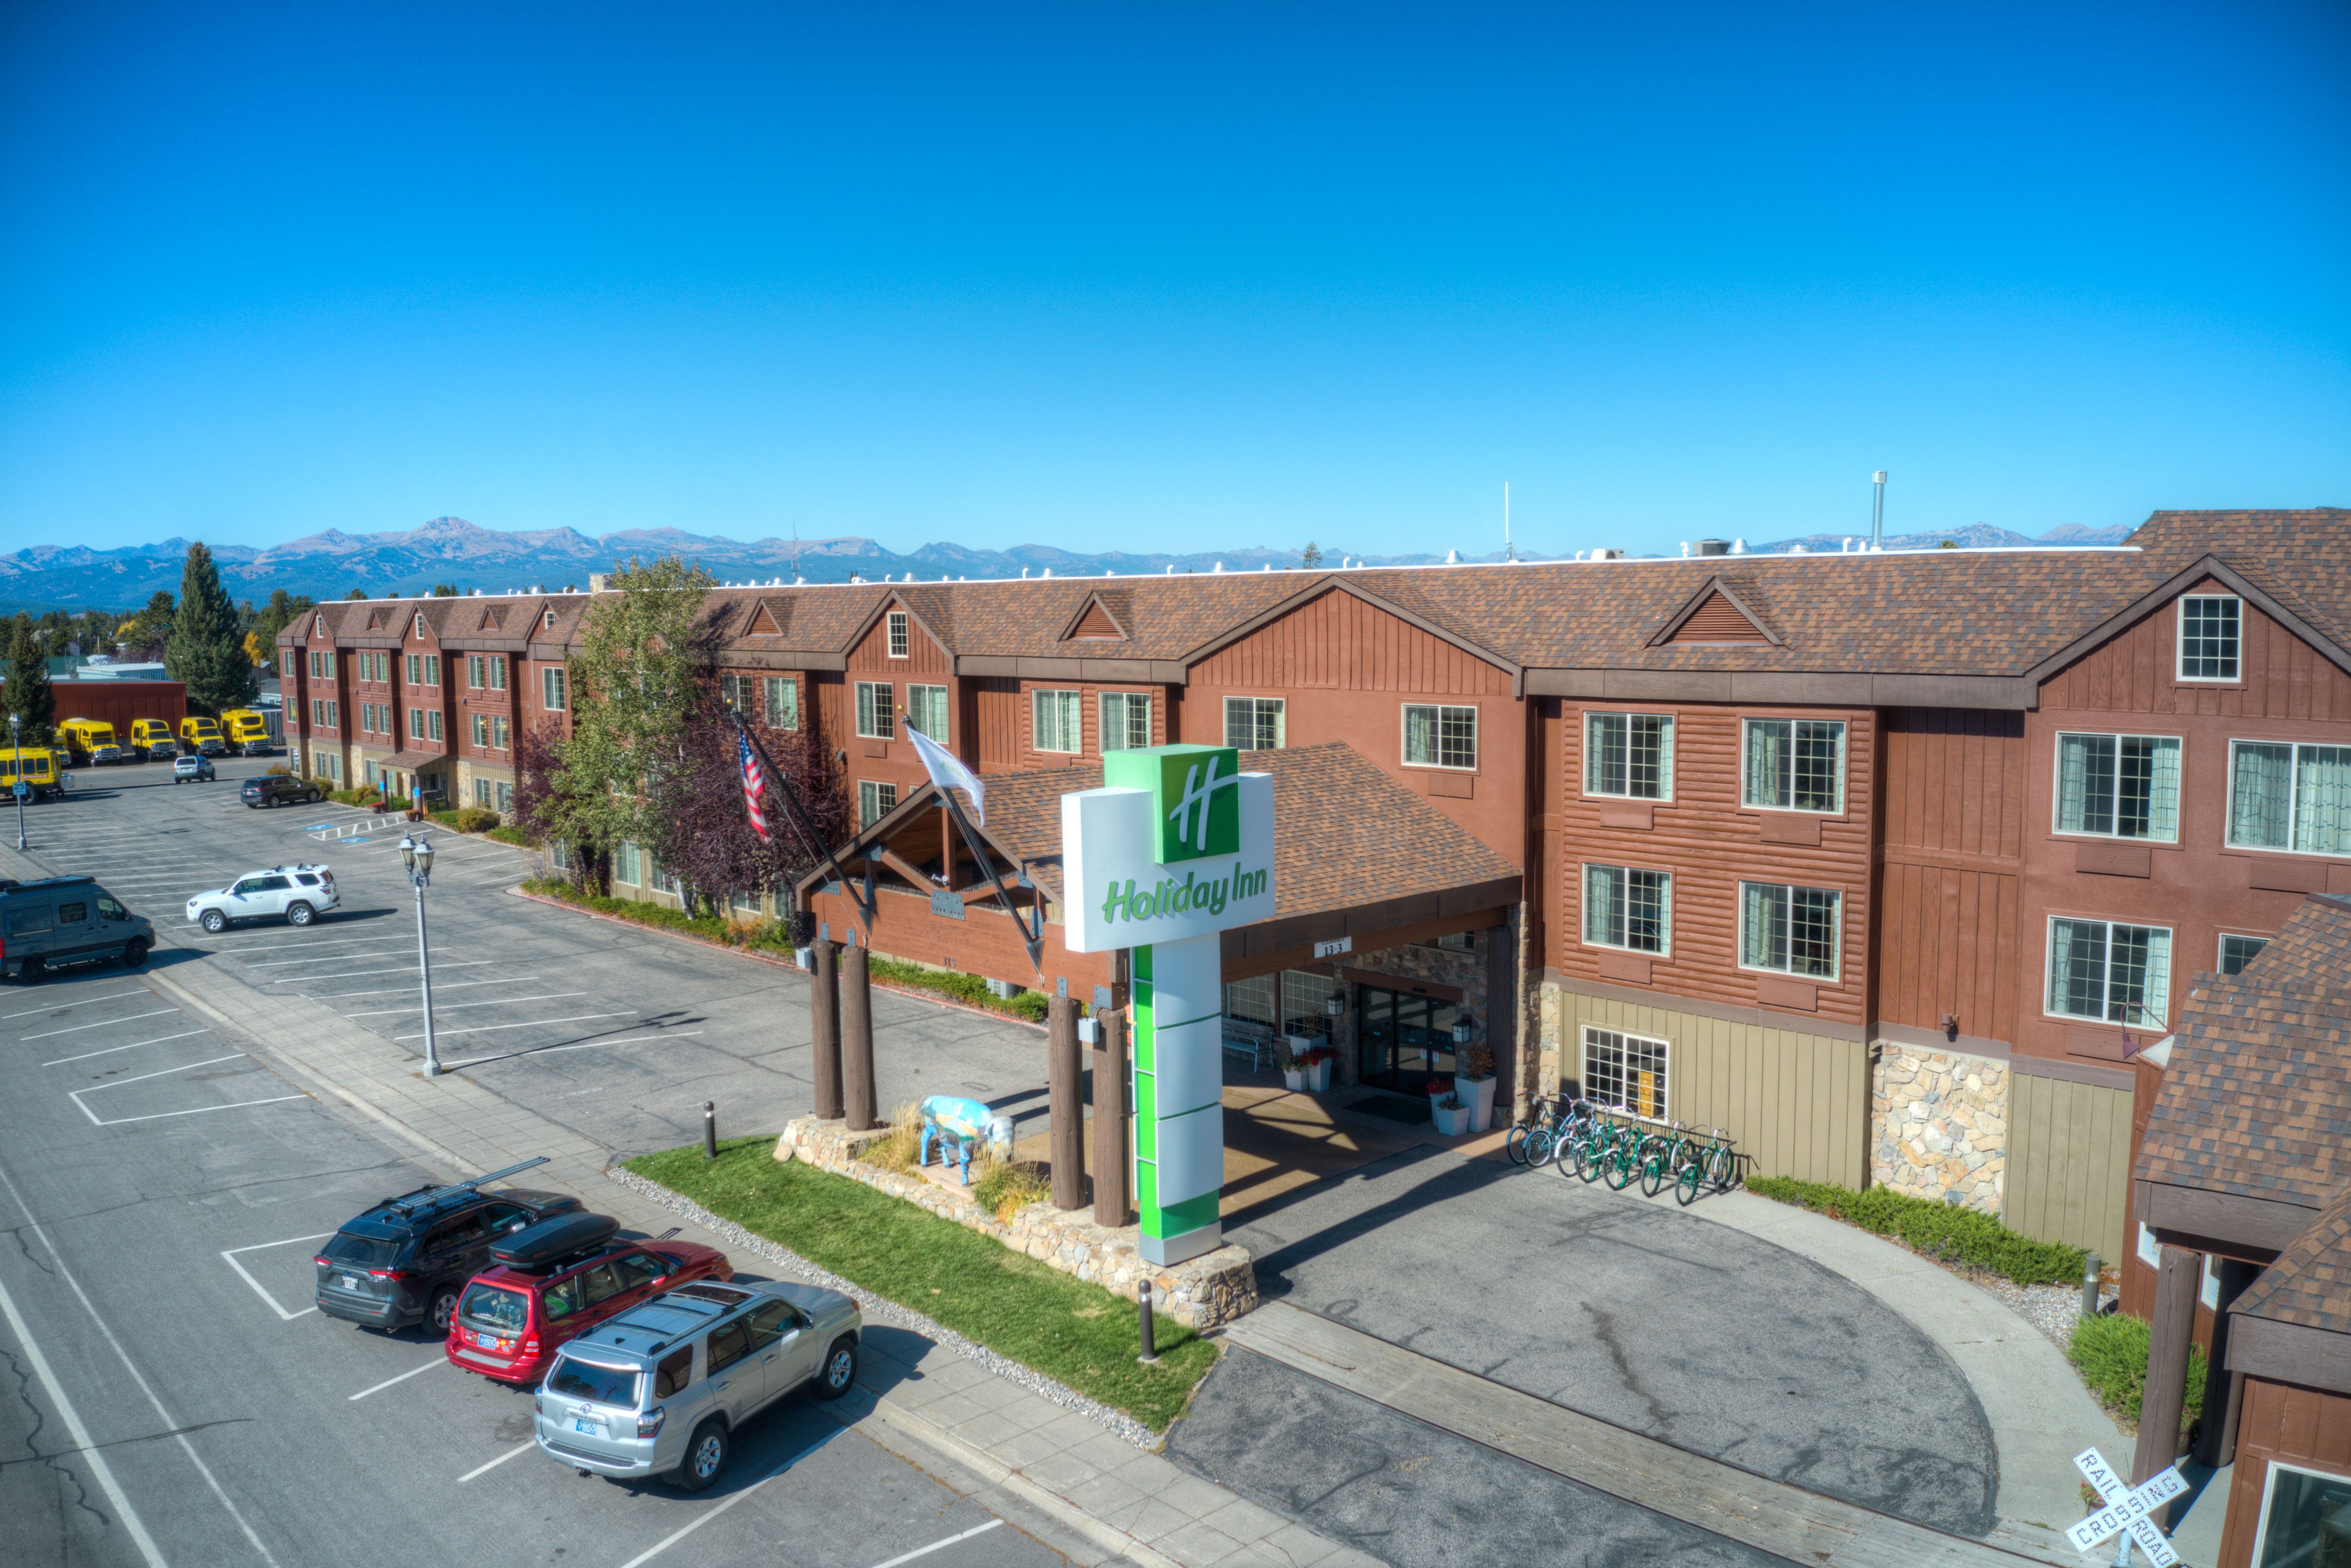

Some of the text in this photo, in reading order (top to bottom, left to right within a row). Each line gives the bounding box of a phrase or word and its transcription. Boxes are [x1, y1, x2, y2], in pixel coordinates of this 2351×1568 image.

[1101, 862, 1267, 923] Holiday Inn
[1324, 943, 1342, 956] 13-3
[2076, 1476, 2178, 1544] CROSSING
[2080, 1454, 2173, 1566] RAIL ROAD
